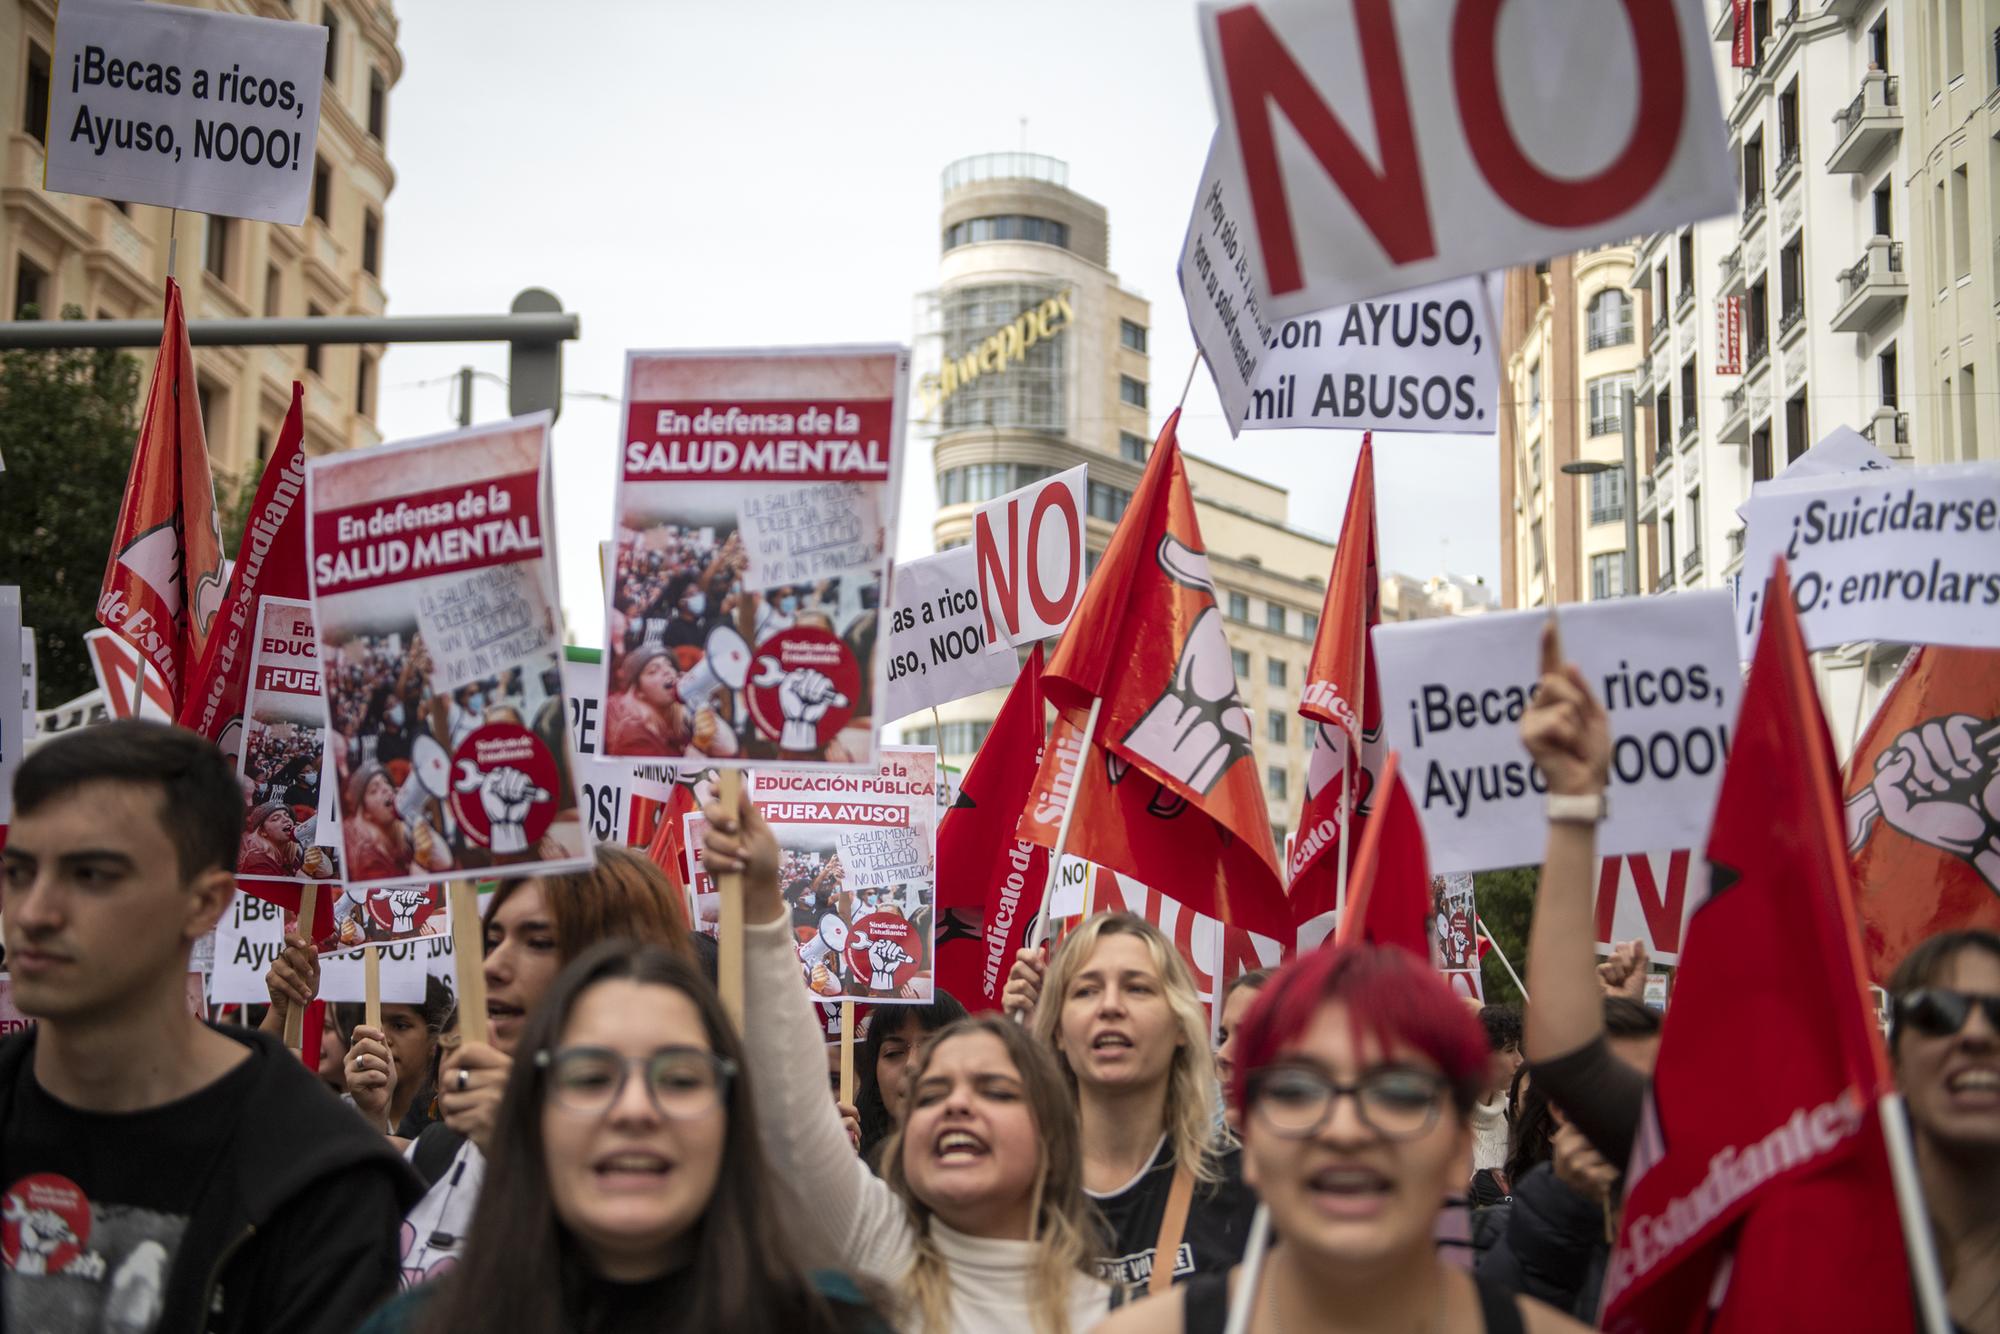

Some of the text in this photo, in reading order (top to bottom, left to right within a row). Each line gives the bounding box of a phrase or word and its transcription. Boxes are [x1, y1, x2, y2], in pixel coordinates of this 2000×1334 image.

[71, 46, 304, 119] ¡Becas a ricos,
[70, 104, 302, 171] Ayuso, NOOO!
[1215, 0, 1688, 297] NO
[1205, 271, 1219, 300] su
[1215, 288, 1240, 337] salud
[1338, 299, 1483, 355] AYUSO,
[1311, 374, 1485, 421] ABUSOS.
[656, 405, 860, 434] En defensa de la
[625, 440, 888, 472] SALUD MENTAL
[337, 484, 512, 543] En defensa de la
[1786, 489, 2000, 561] ¿Suicidarse
[315, 514, 541, 588] SALUD MENTAL
[976, 481, 1081, 645] NO
[98, 590, 130, 623] de
[888, 606, 915, 635] as
[921, 601, 935, 625] a
[1746, 570, 1833, 636] ¡O:
[220, 629, 241, 673] de
[262, 637, 317, 659] EDUC
[930, 624, 986, 666] NOO
[1410, 660, 1725, 749] ¡Beca ricos,
[893, 762, 907, 777] la
[1607, 725, 1732, 786] OOO!
[755, 776, 858, 793] EDUCACIÓN
[861, 777, 935, 795] PÚBLICA
[760, 803, 906, 823] ¡FUERA AYUSO!
[840, 825, 920, 847] LA SALUD MENTAL
[851, 848, 919, 869] UN DERECHO
[855, 872, 869, 886] NO
[870, 870, 884, 885] UN
[1062, 861, 1088, 887] NO
[234, 894, 280, 930] ¡Be
[869, 921, 899, 930] Sindicato
[869, 928, 908, 936] Estudiantes
